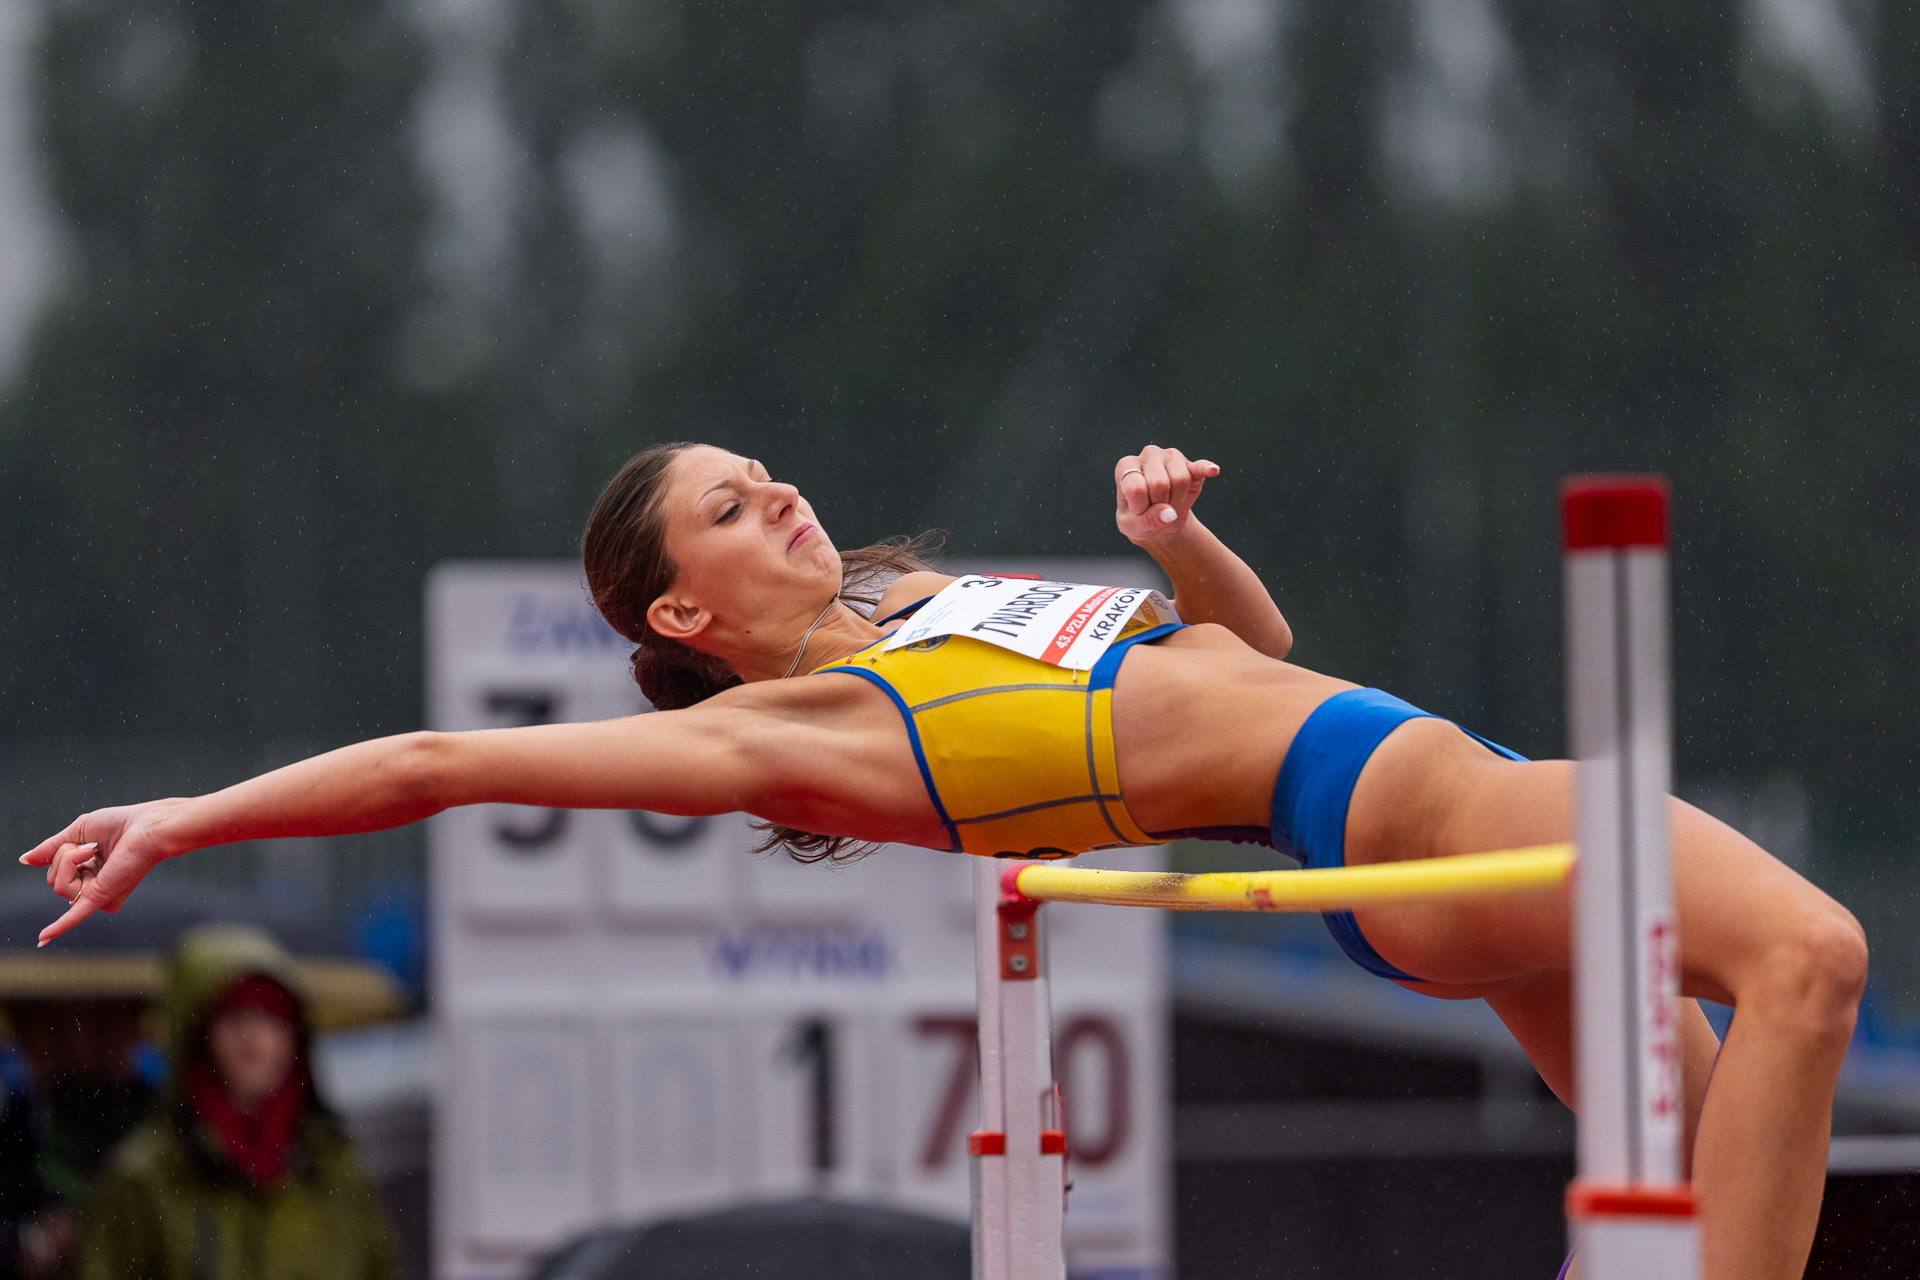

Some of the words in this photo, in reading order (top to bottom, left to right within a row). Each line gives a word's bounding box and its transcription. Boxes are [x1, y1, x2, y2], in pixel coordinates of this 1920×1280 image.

[961, 576, 1003, 588] 3
[971, 583, 1076, 638] TWARDO
[1055, 635, 1074, 650] 43.
[1065, 613, 1090, 635] PZLA
[774, 1015, 839, 1172] 1
